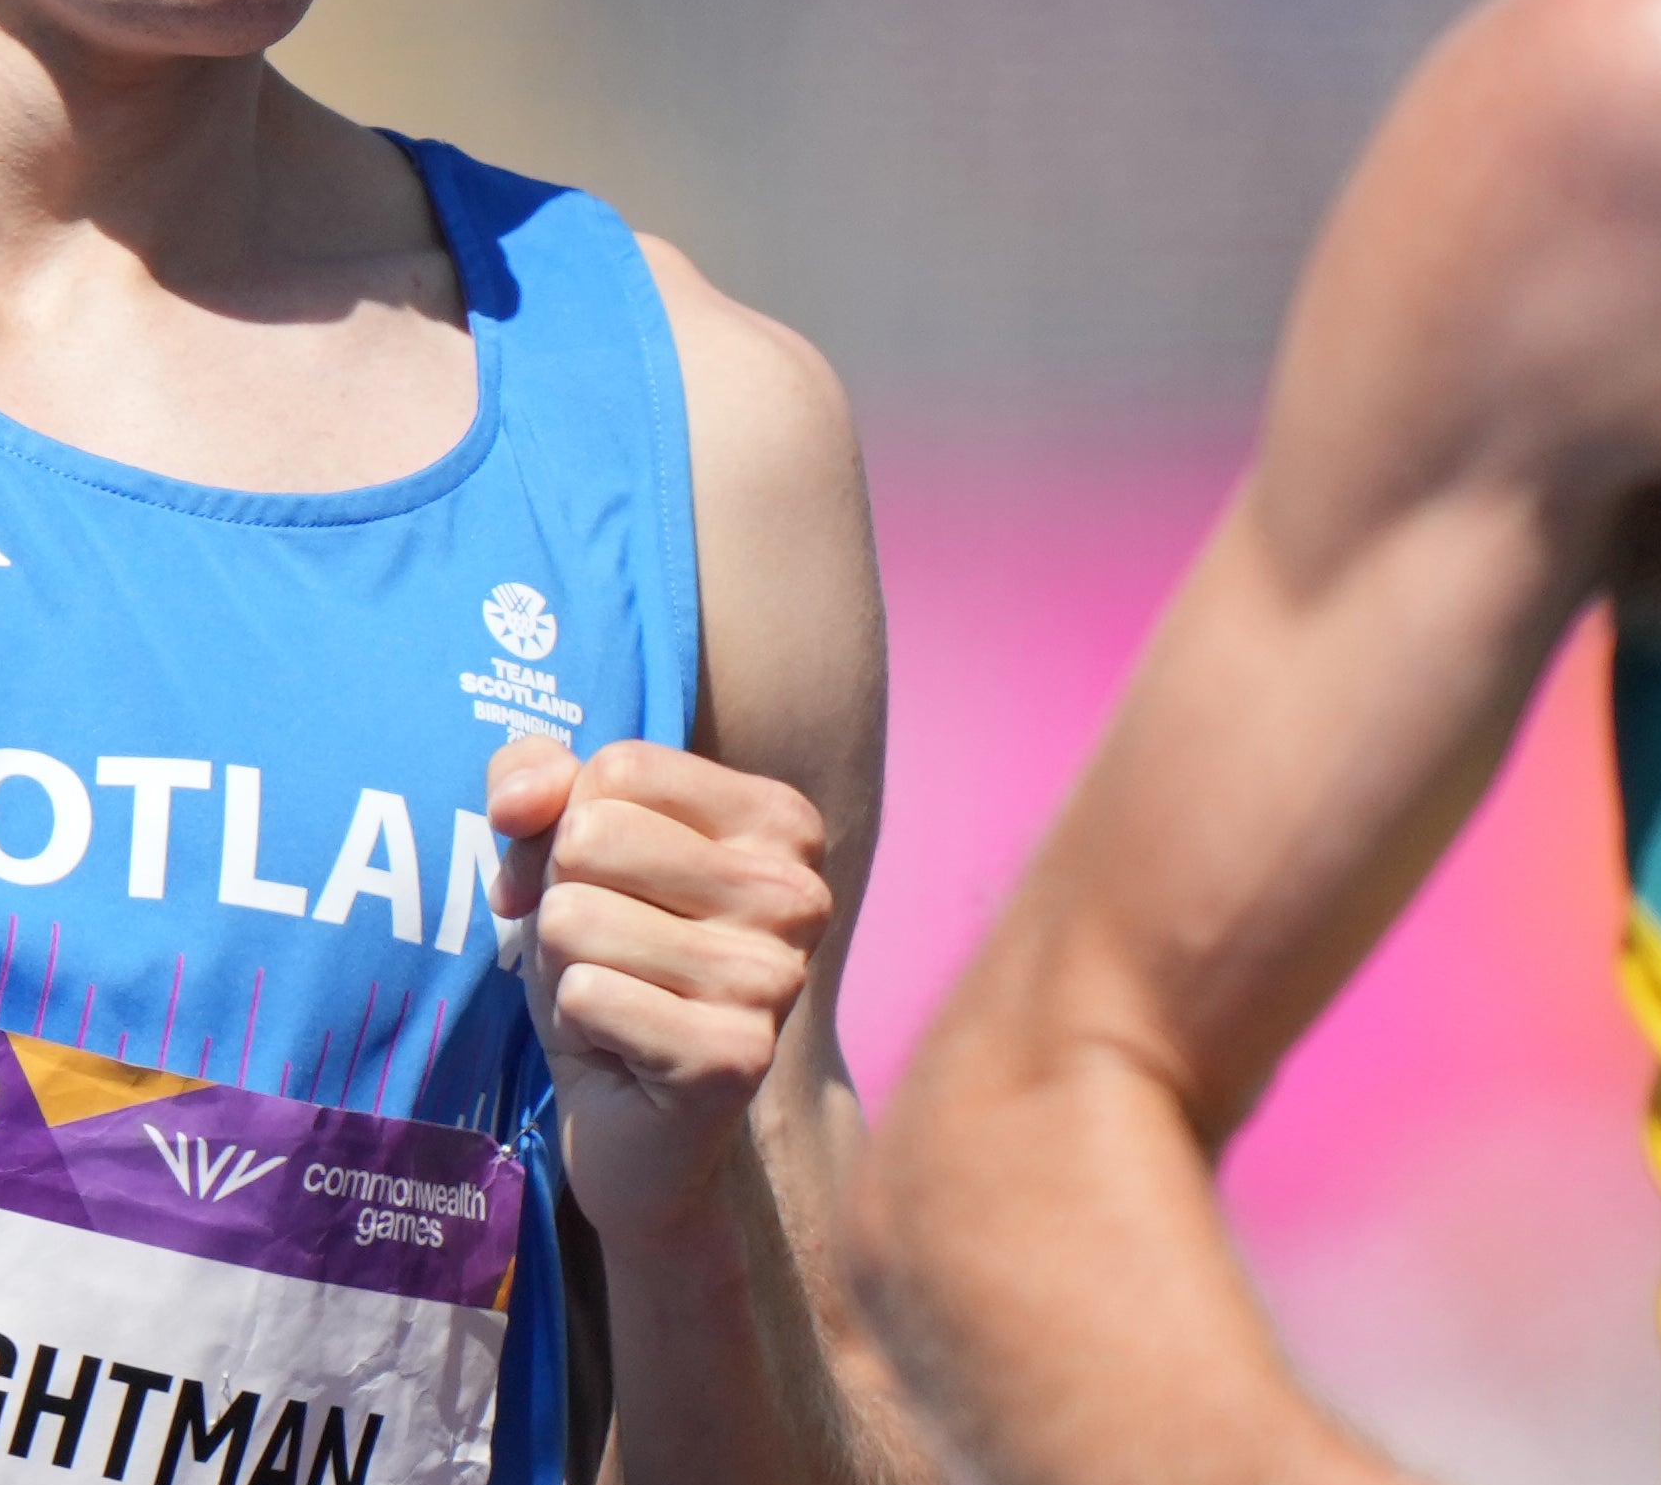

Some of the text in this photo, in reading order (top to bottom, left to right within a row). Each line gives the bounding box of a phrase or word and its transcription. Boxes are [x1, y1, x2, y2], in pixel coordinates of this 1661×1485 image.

[458, 672, 585, 726] SCOTLAND
[490, 656, 557, 696] TEAM
[473, 699, 573, 750] BIRMINGHAM
[302, 1162, 487, 1222] commonwealth
[354, 1206, 445, 1249] games
